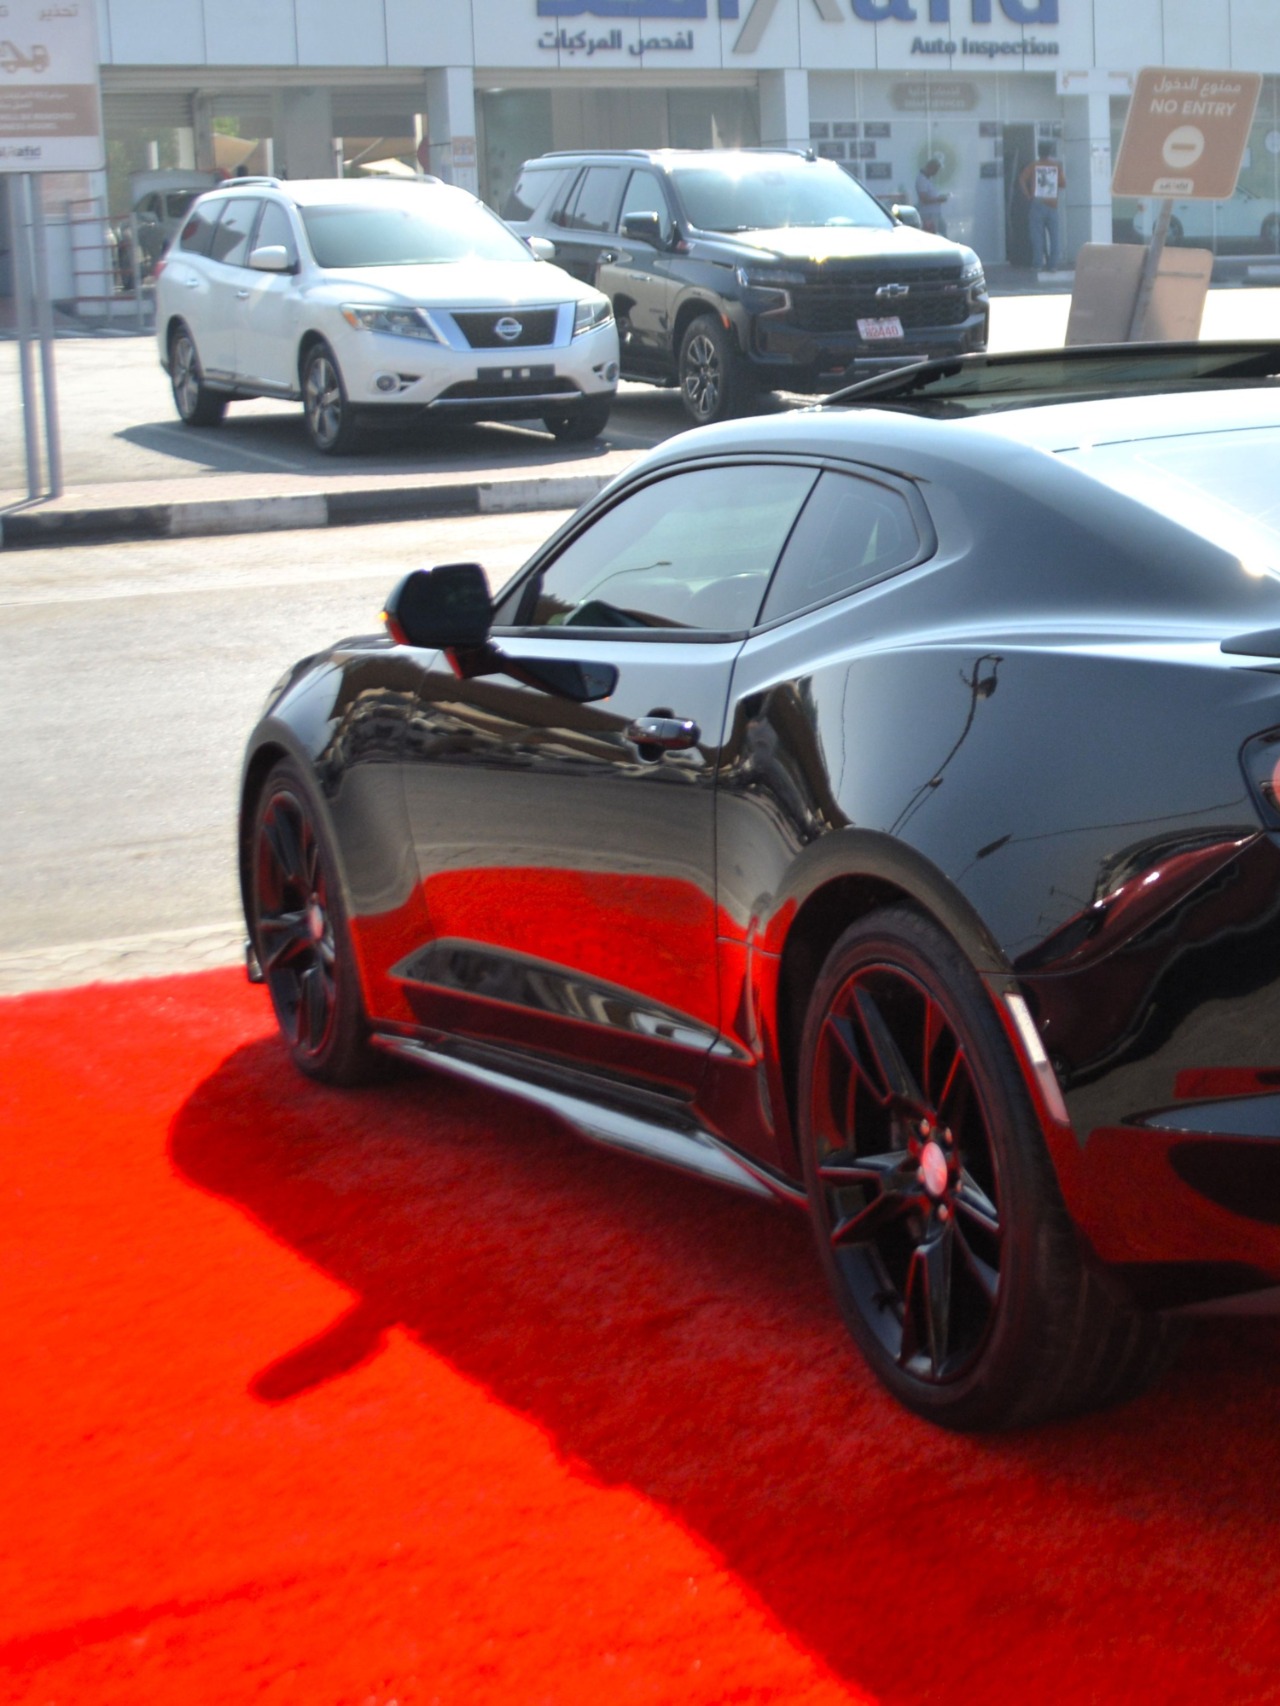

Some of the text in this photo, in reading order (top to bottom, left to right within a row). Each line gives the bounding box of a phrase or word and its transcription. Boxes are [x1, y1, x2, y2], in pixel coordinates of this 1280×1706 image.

[537, 29, 694, 56] لفحص المركبات
[910, 36, 1060, 58] Auto Inspection
[1153, 75, 1199, 93] الدخول
[1200, 78, 1242, 97] ممنوع
[1151, 99, 1237, 117] NO ENTRY
